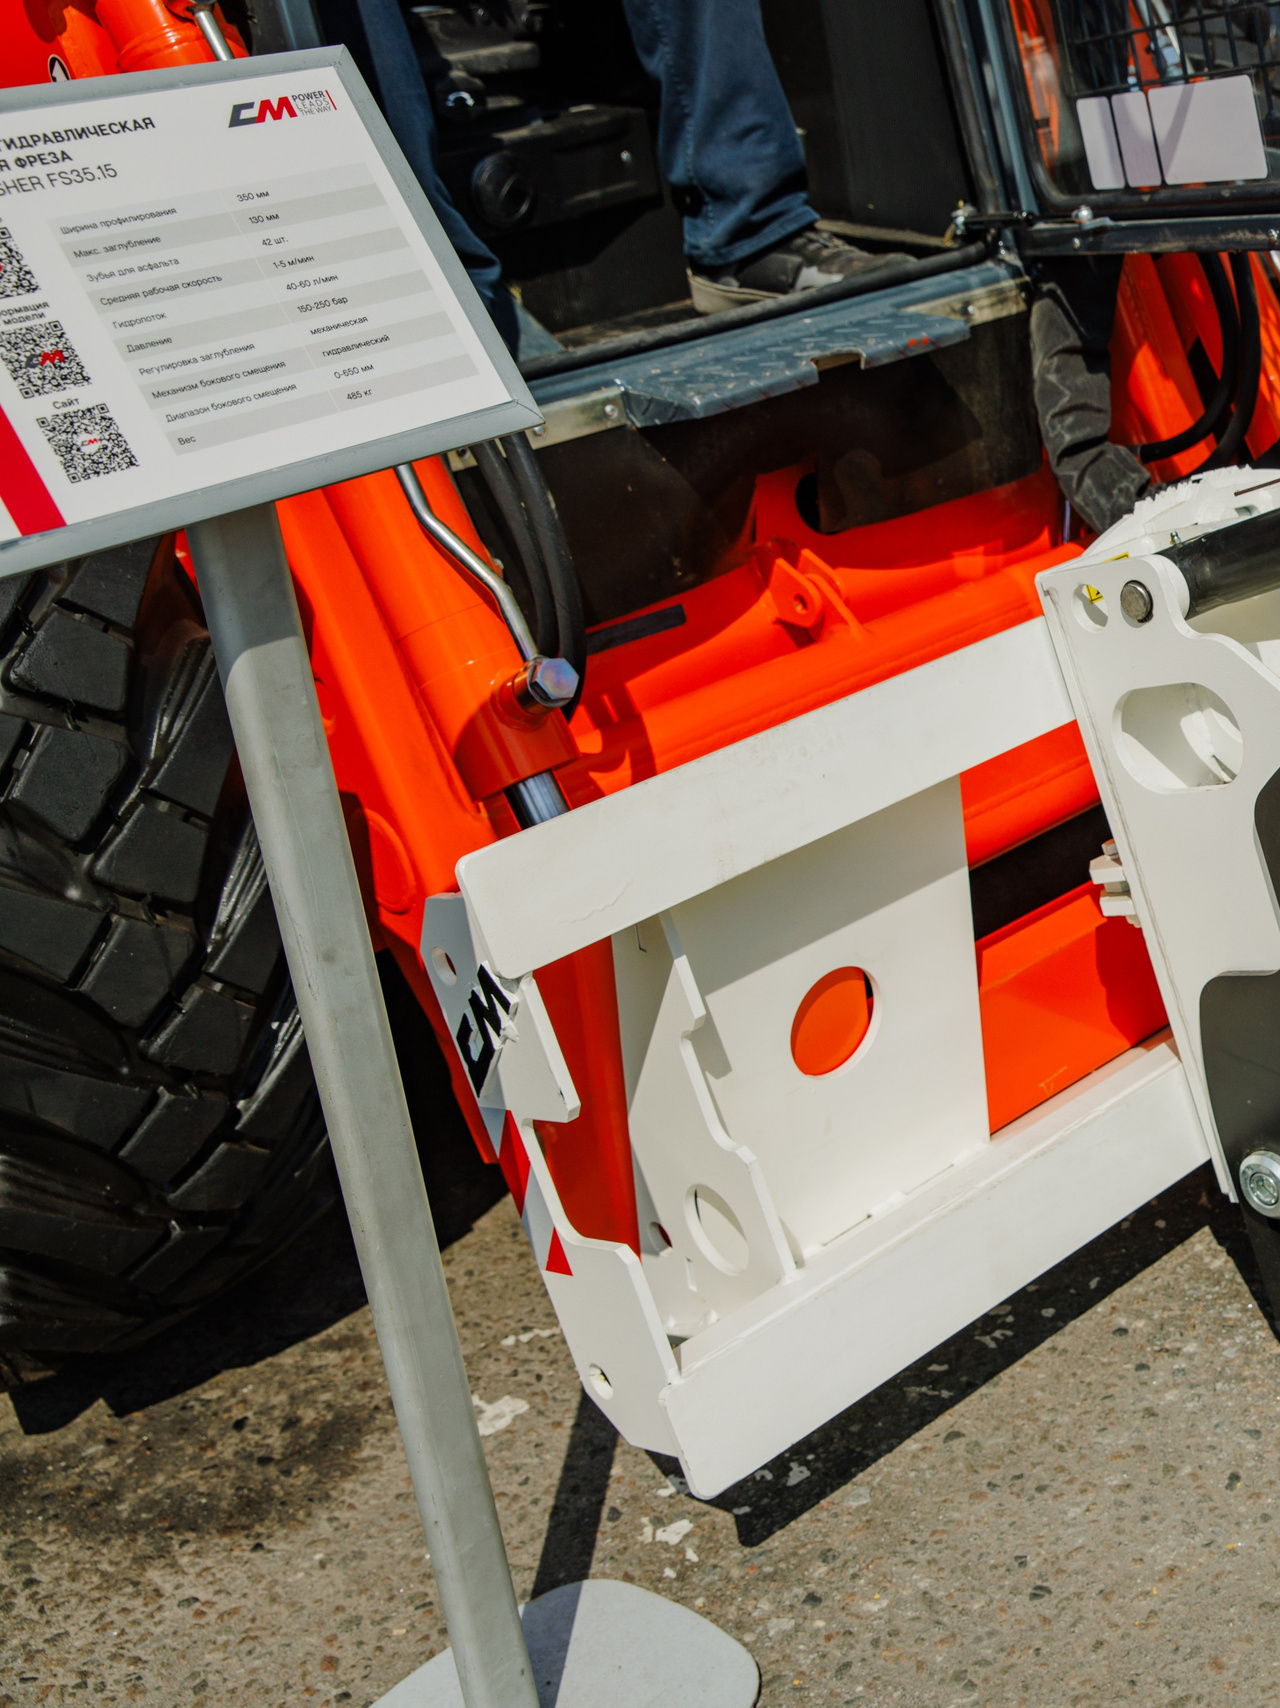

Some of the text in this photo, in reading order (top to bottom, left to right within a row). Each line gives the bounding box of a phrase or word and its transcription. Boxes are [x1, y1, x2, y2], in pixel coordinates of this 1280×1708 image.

[291, 90, 326, 103] POWER
[295, 97, 330, 110] LEADS
[300, 105, 333, 116] THE WAY
[0, 117, 156, 150] ИДРАВЛИЧЕСКАЯ
[14, 150, 73, 169] ФРЕЗА
[46, 164, 118, 188] FS35.15
[237, 191, 270, 202] 350 мм
[60, 207, 177, 235] Ширина профилирования
[249, 213, 280, 224] 130 мм
[73, 236, 161, 258] Макс. заглубление
[262, 236, 288, 246] 42 шт.
[86, 258, 180, 283] Зубья для асфальта
[273, 255, 315, 269] 1-5 м/мин
[100, 275, 222, 306] Средняя рабочая скорость
[286, 274, 339, 291] 40-60 л/мин
[297, 296, 348, 314] 150-250 бар
[3, 312, 46, 325] модели
[112, 312, 167, 329] Гидропоток
[310, 316, 368, 335] механическая
[127, 337, 173, 353] Давление
[322, 334, 390, 357] гидравлический
[139, 342, 256, 376] Регулировка заглубления
[152, 361, 286, 399] Механизм бокового смещения
[334, 364, 374, 379] 0-650 мм
[346, 388, 373, 400] 485 кг
[52, 398, 80, 409] Сайт
[165, 383, 297, 423] Диапазон бокового смещения
[177, 435, 197, 446] Вес
